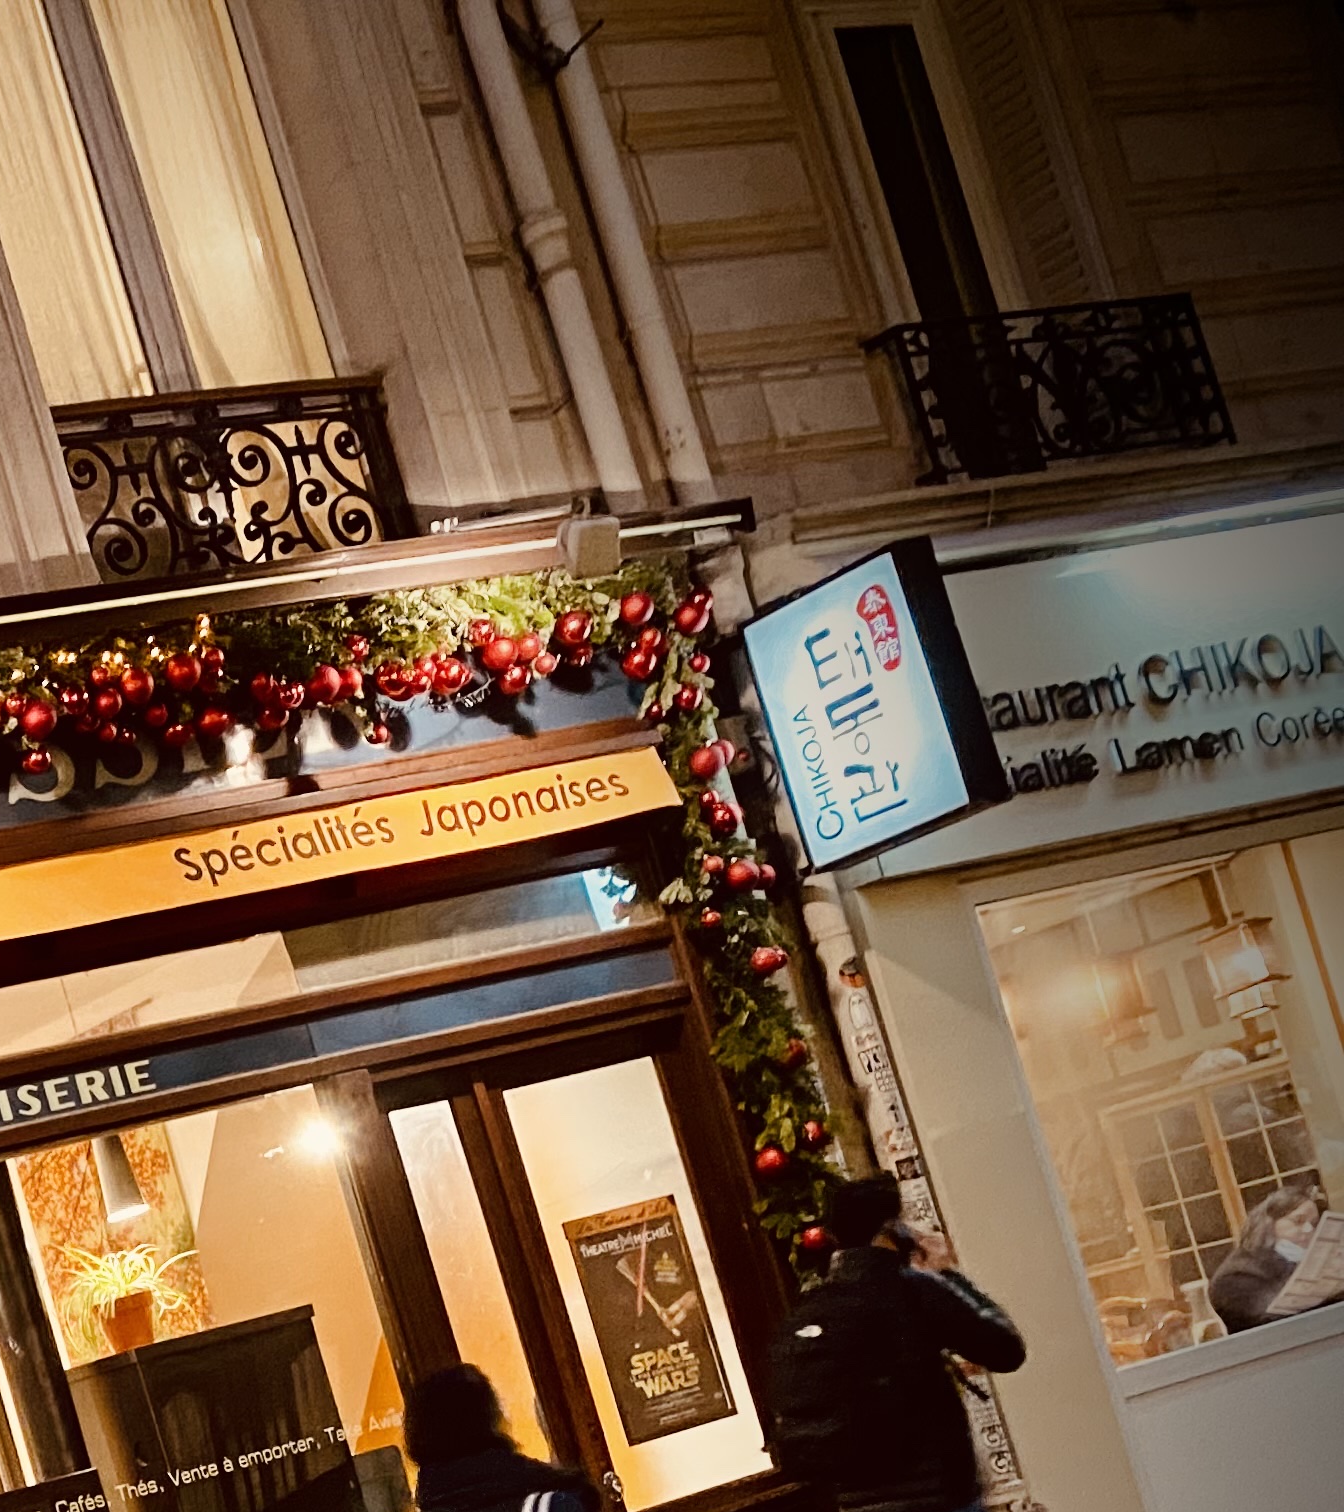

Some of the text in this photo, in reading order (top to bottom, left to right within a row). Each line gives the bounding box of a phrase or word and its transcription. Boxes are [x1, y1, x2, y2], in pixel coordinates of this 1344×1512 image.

[1138, 625, 1344, 705] CHIKOJA
[792, 704, 845, 841] CHIKOJA
[1006, 743, 1100, 793] ialité
[1109, 727, 1245, 774] Lamen
[174, 801, 395, 887] Spécialités
[419, 765, 630, 845] Japonaises
[631, 1340, 695, 1376] SPACE
[634, 1365, 700, 1399] WARS
[116, 1477, 164, 1503] Thés,
[167, 1459, 219, 1488] Vente
[223, 1456, 234, 1473] à
[238, 1435, 322, 1467] emporter,
